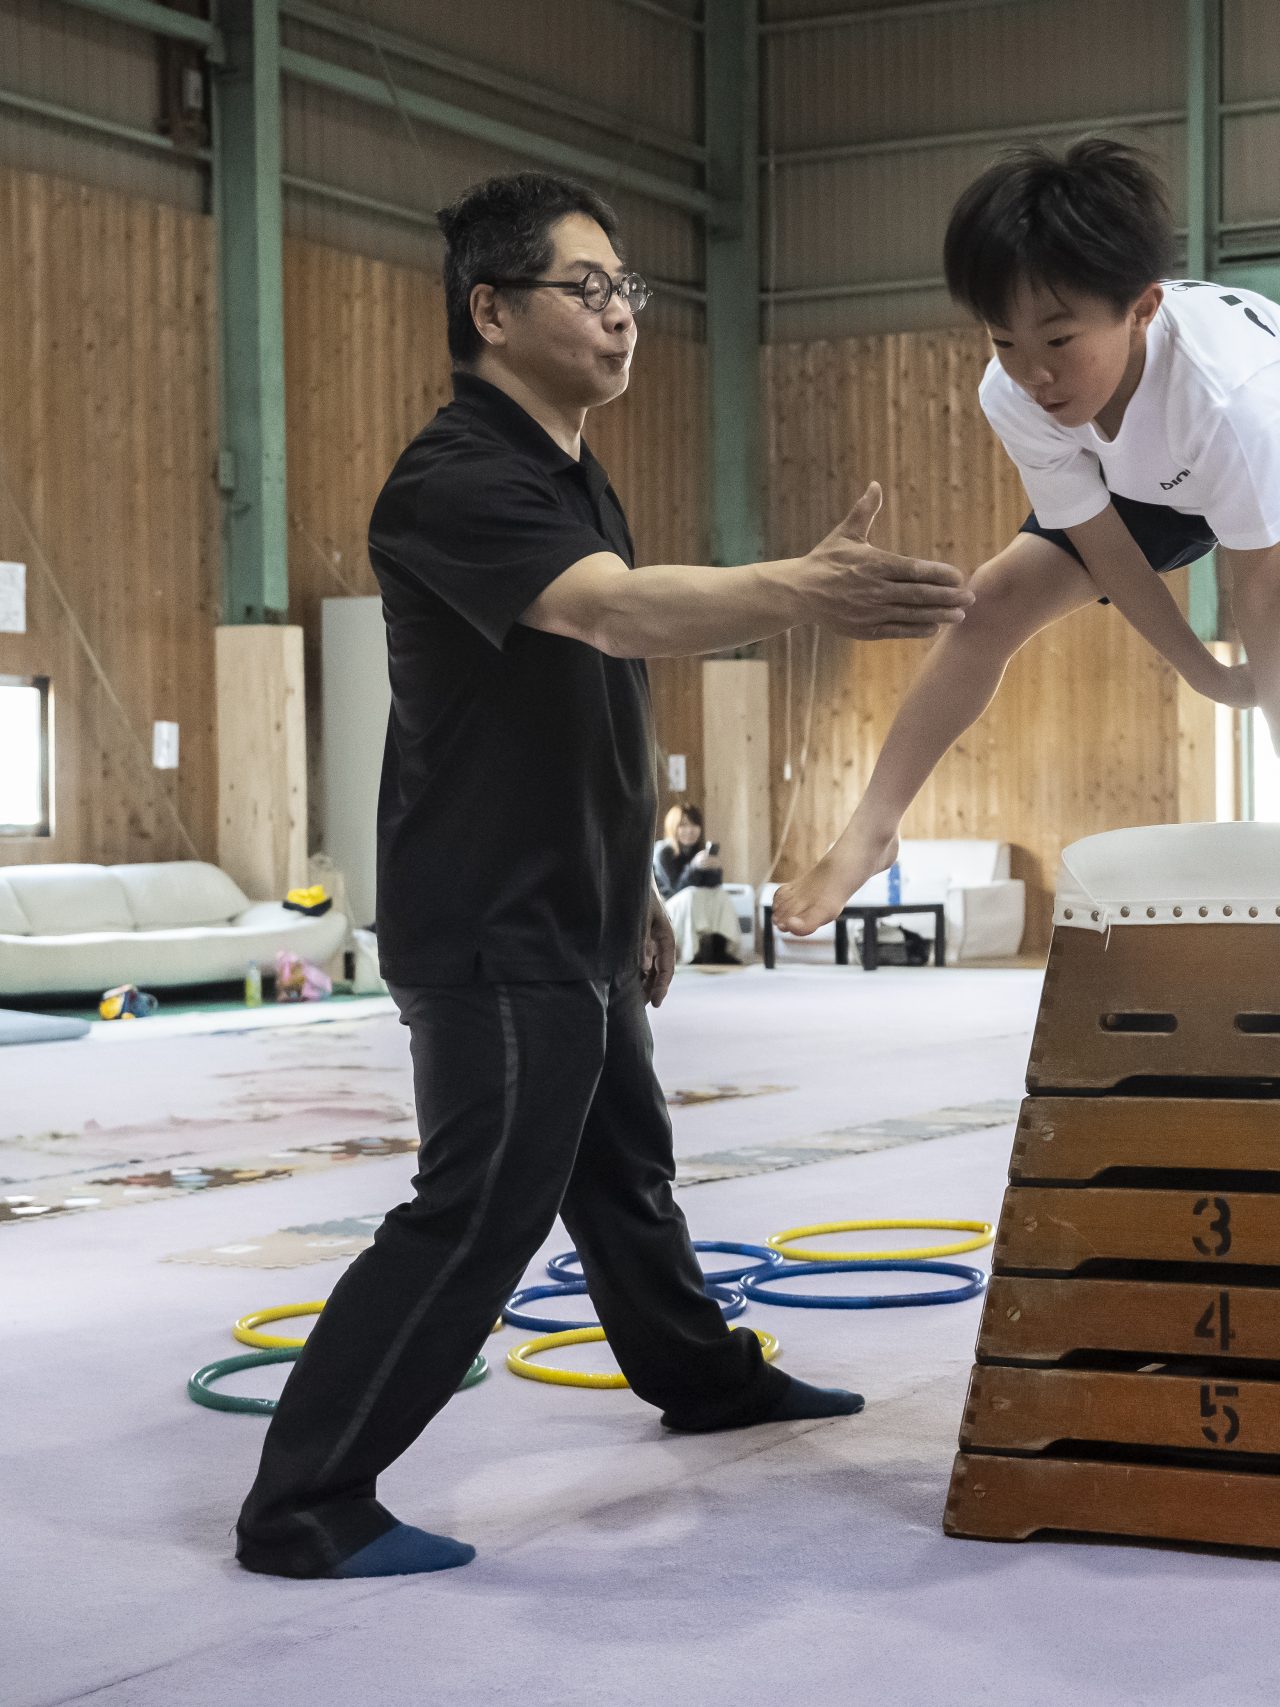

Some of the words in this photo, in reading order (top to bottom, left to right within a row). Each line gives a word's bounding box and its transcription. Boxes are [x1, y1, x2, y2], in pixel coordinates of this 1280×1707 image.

[1192, 1196, 1231, 1257] 3
[1194, 1290, 1236, 1351] 4
[1200, 1384, 1240, 1444] 5
